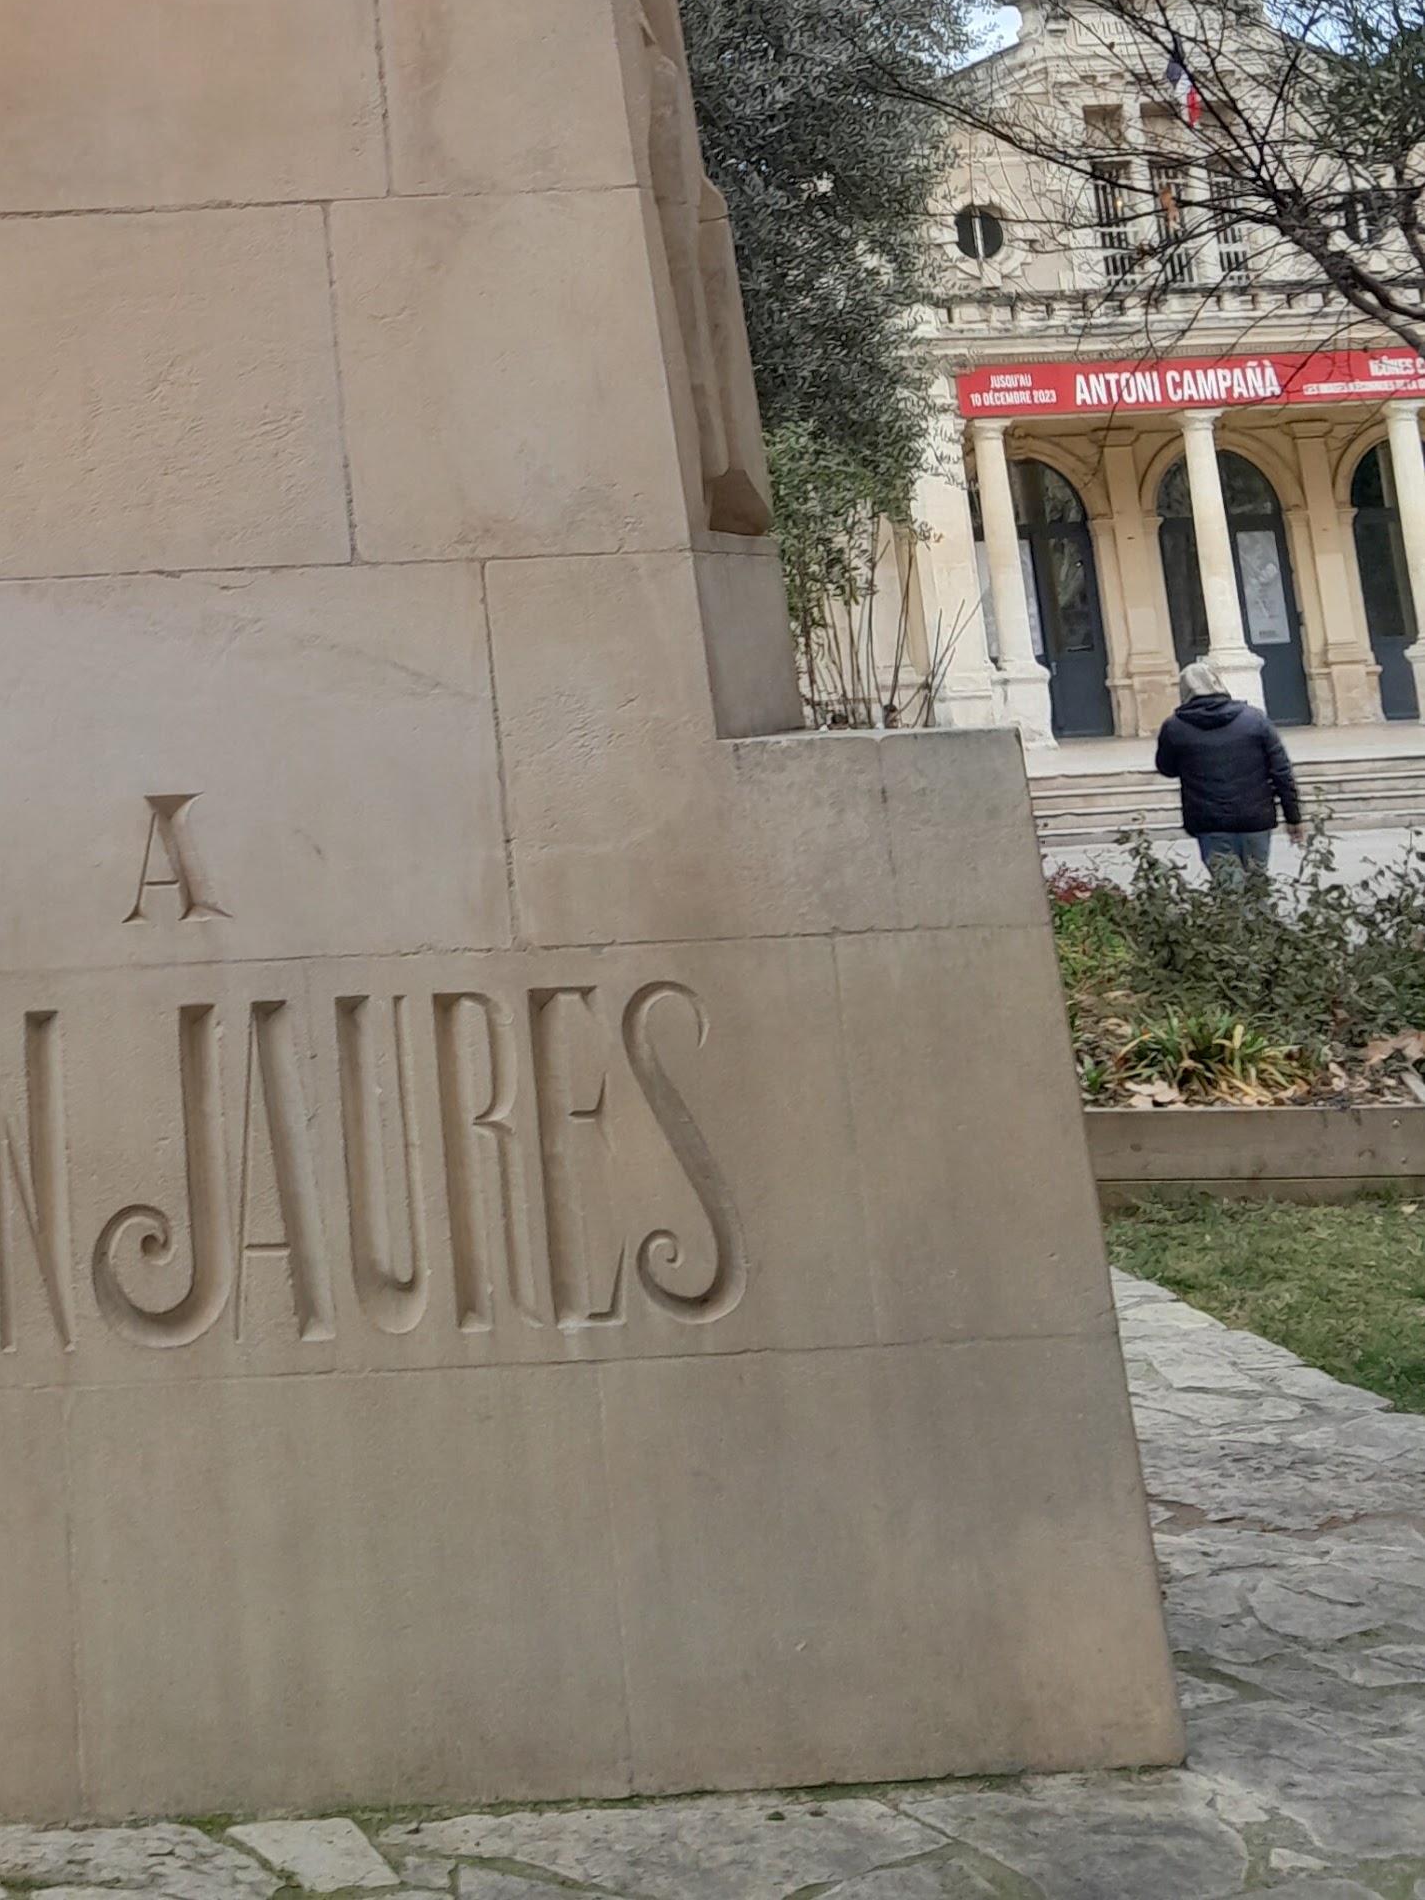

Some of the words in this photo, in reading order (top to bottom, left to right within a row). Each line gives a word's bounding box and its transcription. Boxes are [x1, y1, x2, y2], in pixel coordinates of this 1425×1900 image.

[970, 392, 982, 407] 10
[983, 390, 1033, 406] DÉCEMBRE
[1033, 389, 1057, 404] 2023
[990, 373, 1032, 389] JUSQU'AU
[1075, 371, 1162, 406] ANTONI
[1166, 359, 1282, 402] CAMPAÑÀ
[121, 790, 233, 924] A
[91, 980, 747, 1349] JAURES
